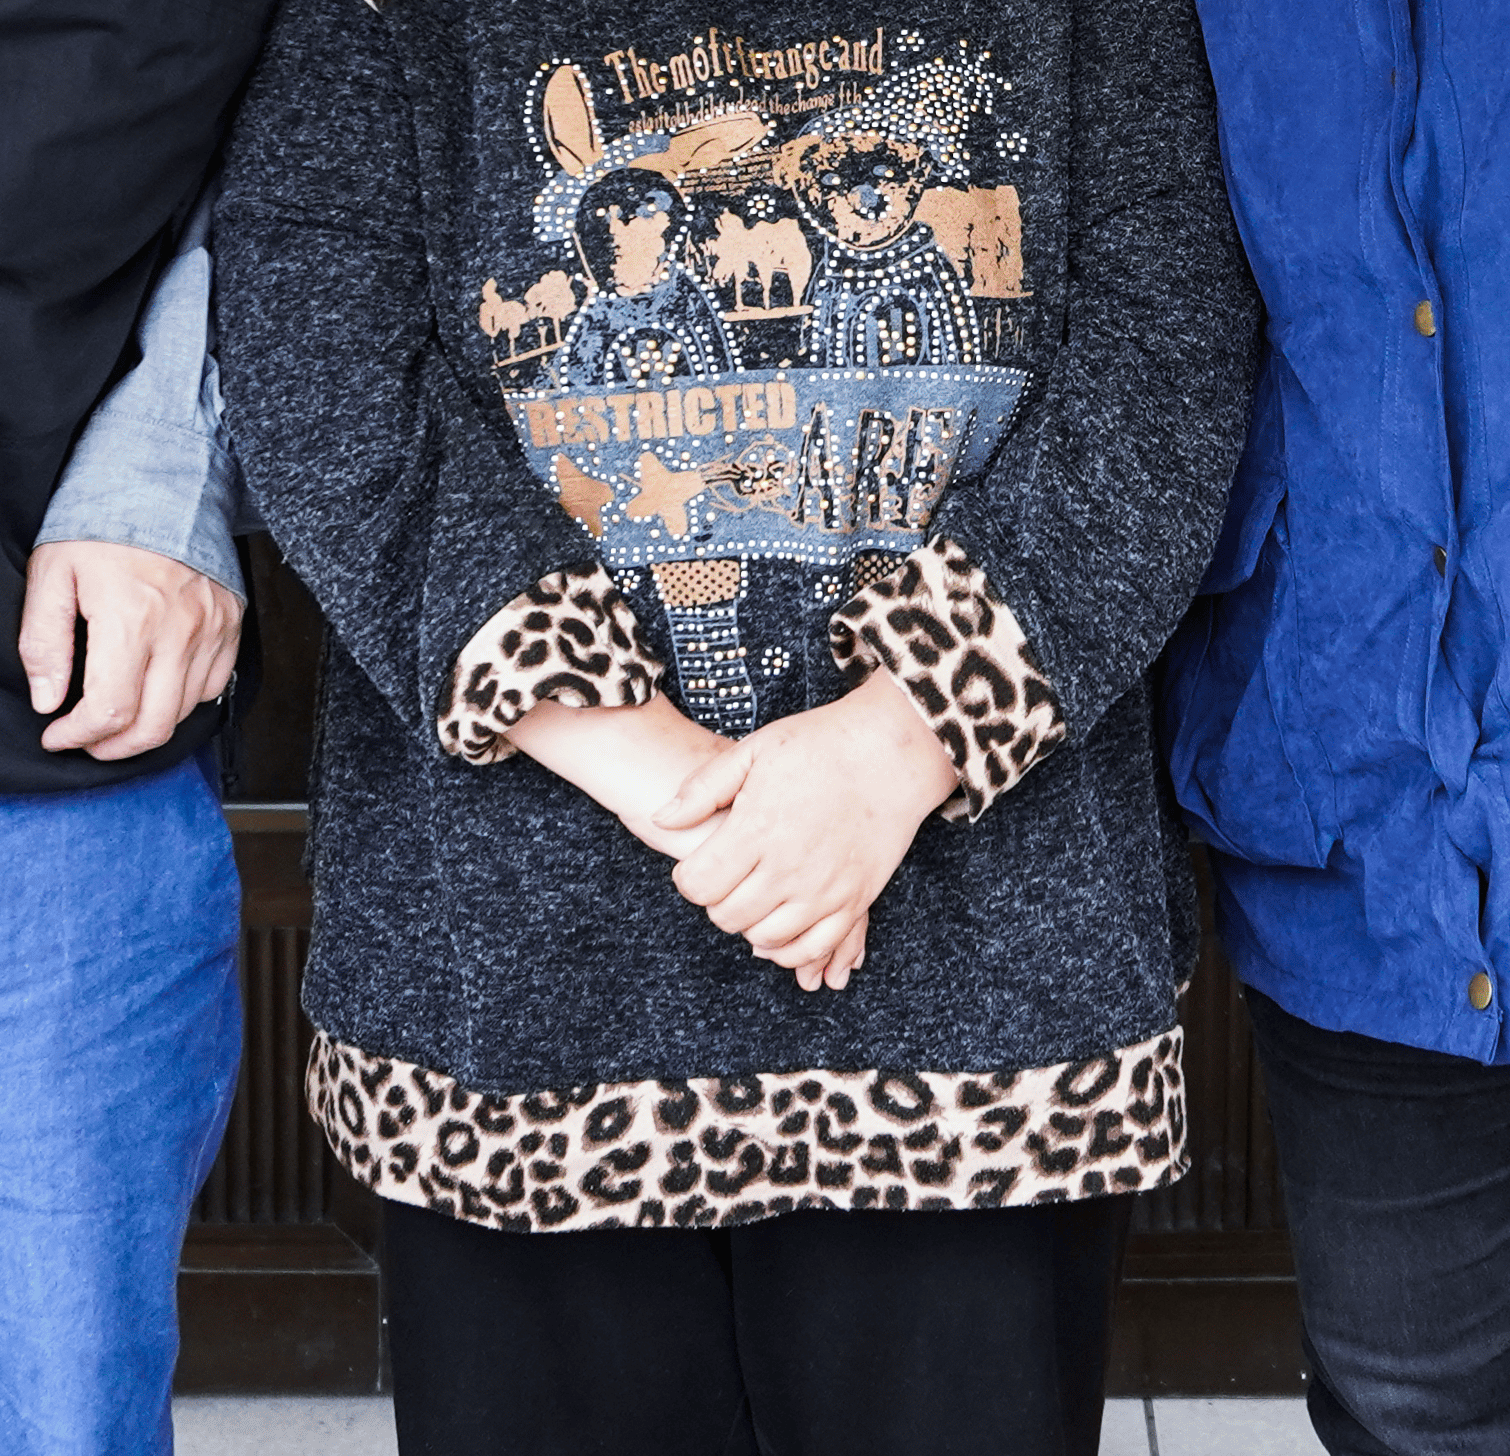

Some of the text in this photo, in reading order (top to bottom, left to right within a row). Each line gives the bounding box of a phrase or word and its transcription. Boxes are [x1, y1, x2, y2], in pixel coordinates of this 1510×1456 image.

[603, 48, 666, 103] The
[837, 27, 884, 75] and
[526, 381, 796, 447] RESTRICTED
